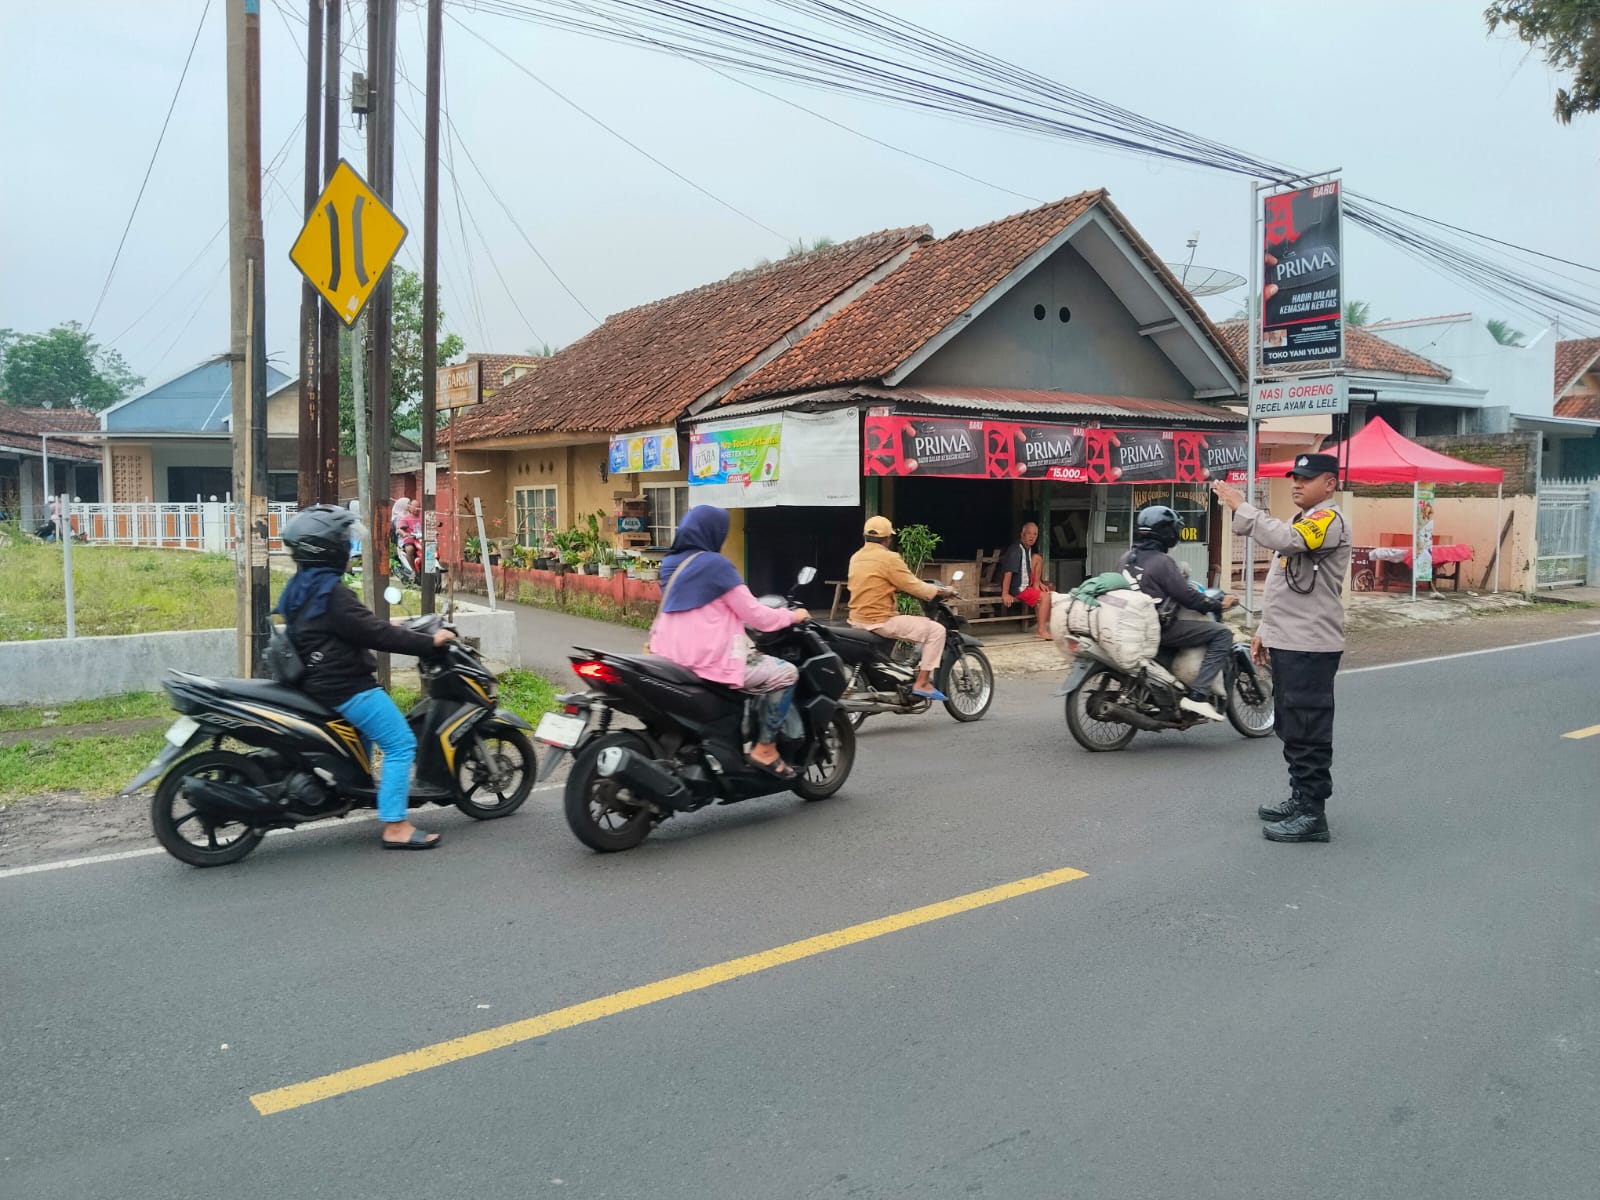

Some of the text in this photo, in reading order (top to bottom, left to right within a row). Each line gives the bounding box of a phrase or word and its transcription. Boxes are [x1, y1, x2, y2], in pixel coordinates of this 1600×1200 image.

[1312, 183, 1336, 198] BARU
[1276, 251, 1336, 281] PRIMA
[1292, 289, 1337, 304] HADIR DALAM
[1280, 299, 1337, 315] KEMASAN KERTAS
[1268, 346, 1337, 360] TOKO YANI YULIANI
[1259, 383, 1334, 400] NASI GORENG
[1255, 398, 1338, 413] PECEL AYAM & LELE
[915, 434, 971, 457] PRIMA
[1025, 440, 1072, 461] PRIMA
[1120, 443, 1165, 465] PRIMA
[1208, 446, 1248, 466] PRIMA
[1053, 468, 1081, 478] 15.000
